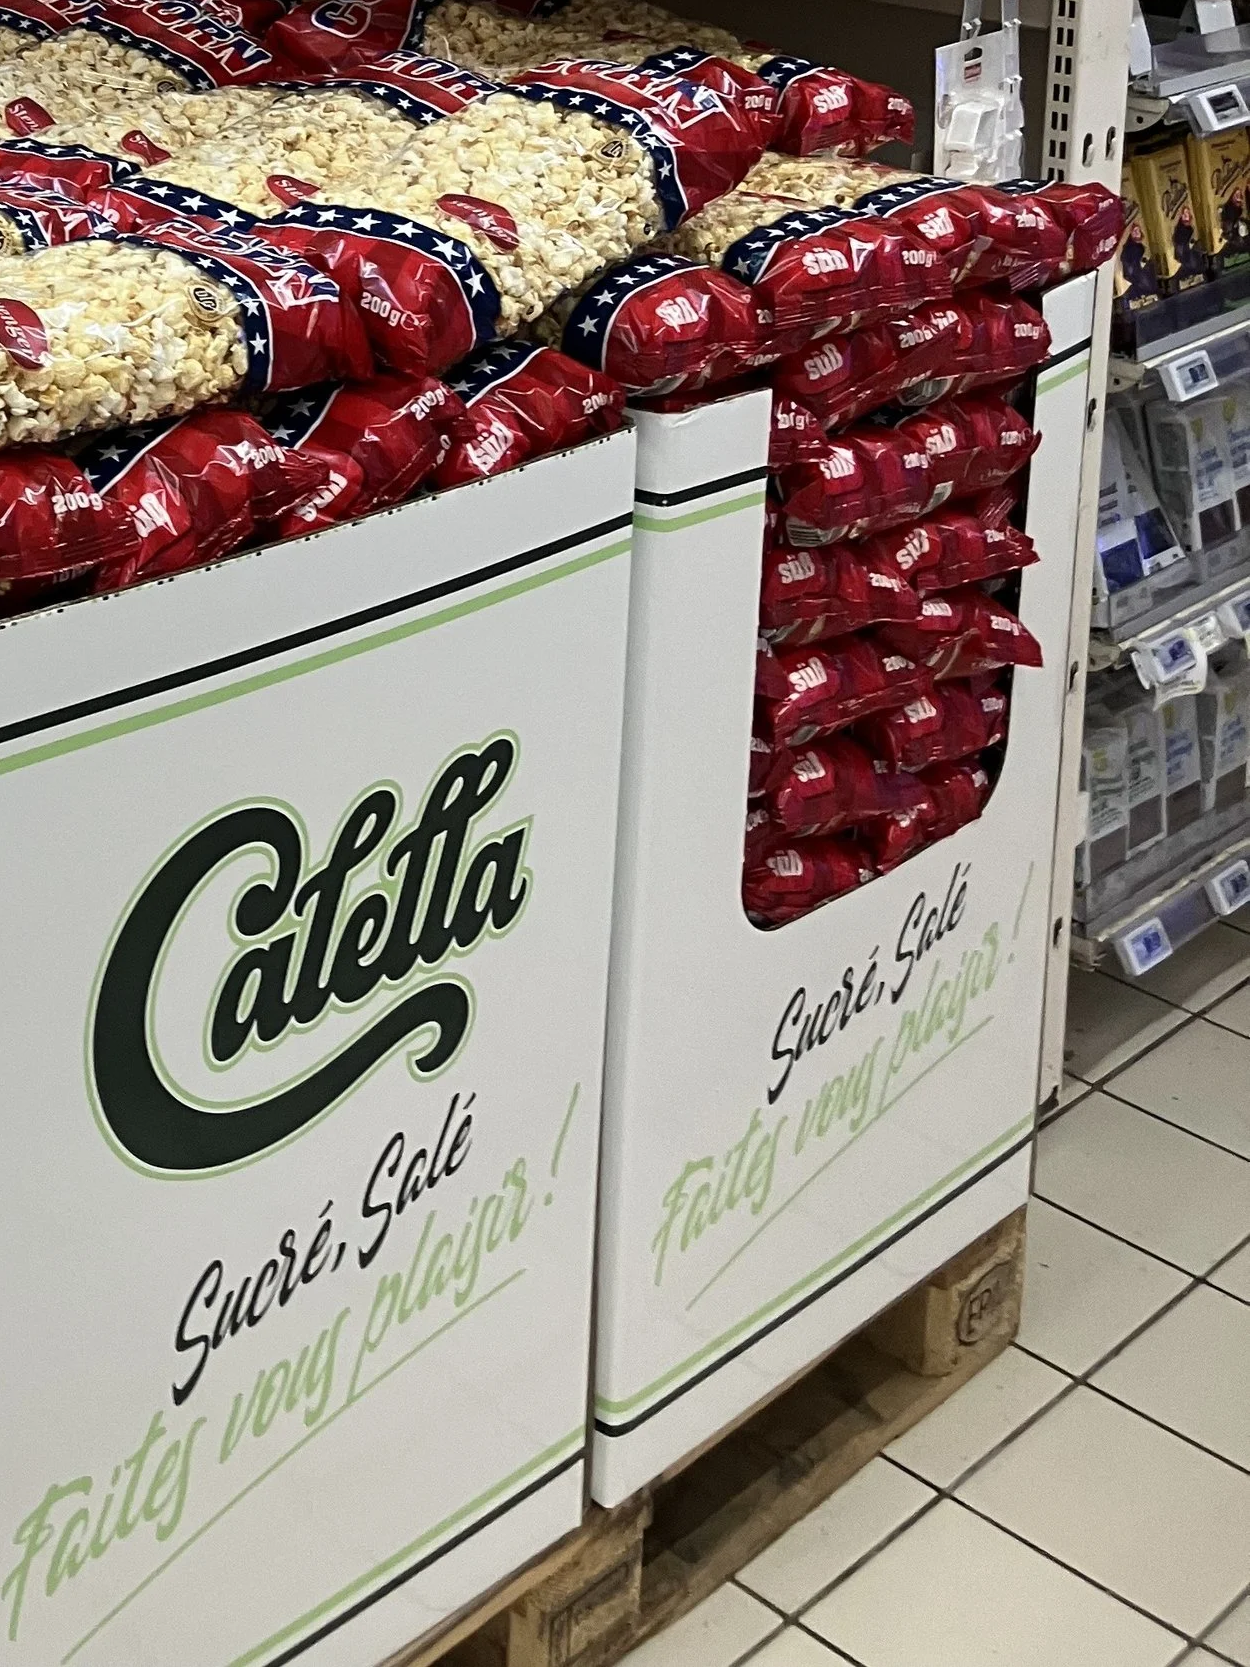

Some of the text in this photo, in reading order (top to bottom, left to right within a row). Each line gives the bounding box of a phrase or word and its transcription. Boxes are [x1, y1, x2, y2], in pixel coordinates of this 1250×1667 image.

[918, 207, 955, 239] süß
[802, 248, 847, 275] süß
[361, 292, 402, 328] 200g
[804, 346, 843, 380] süß
[926, 426, 957, 455] süß
[51, 491, 104, 514] 200g
[777, 552, 816, 584] süß
[789, 657, 827, 693] süß
[892, 861, 971, 1002] Salé
[652, 1107, 781, 1286] Faites
[794, 1034, 885, 1157] vous
[171, 1091, 476, 1406] Sucré, Salé
[1, 1405, 197, 1641] Faites
[224, 1303, 355, 1442] vous
